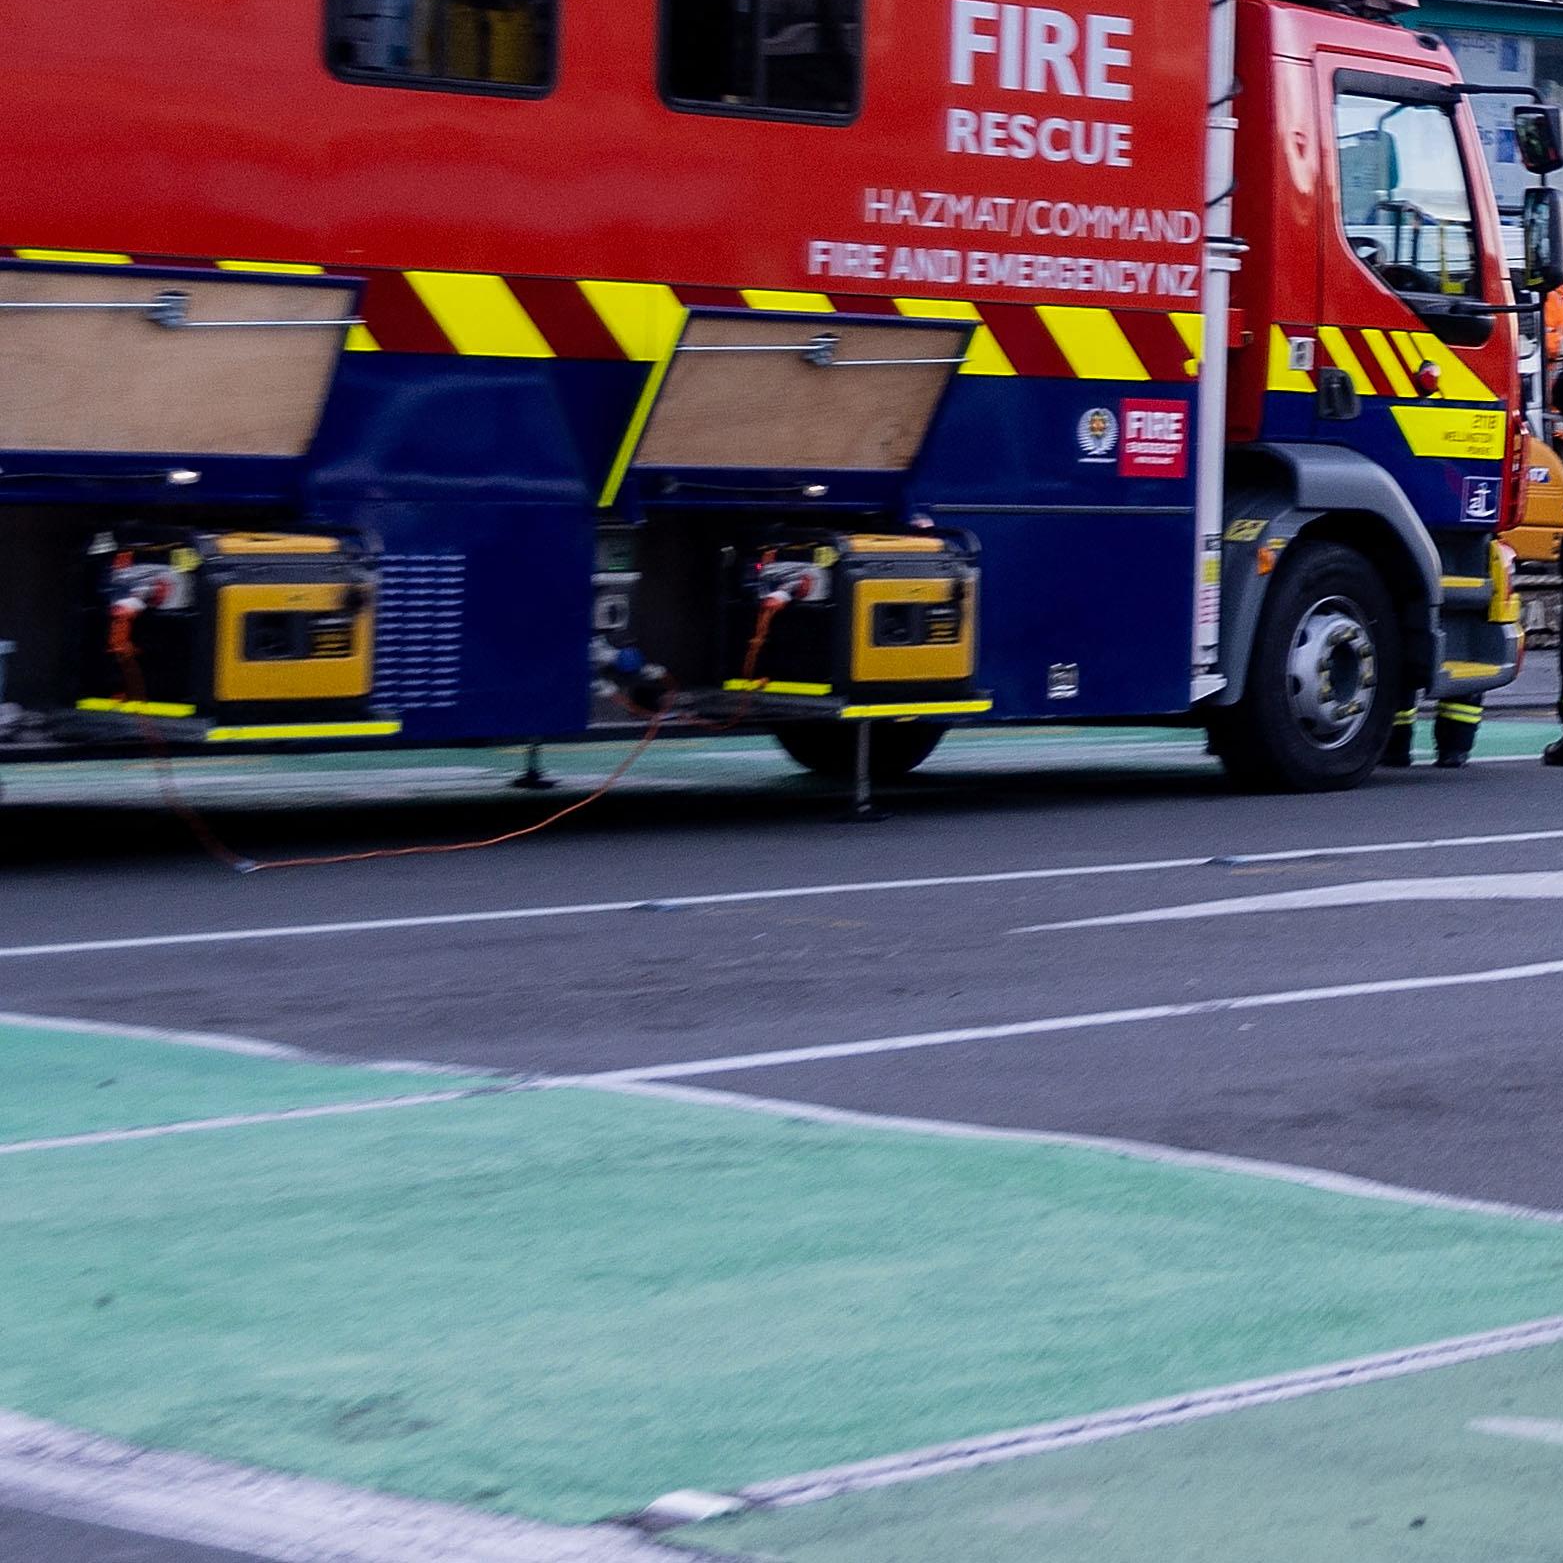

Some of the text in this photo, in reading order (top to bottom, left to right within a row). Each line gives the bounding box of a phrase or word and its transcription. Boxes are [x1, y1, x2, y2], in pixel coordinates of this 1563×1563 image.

[946, 107, 1134, 168] RESCUE
[863, 188, 1201, 245] HAZMAT/COMMAND
[807, 240, 1200, 297] FIRE AND EMERGENCY NZ
[1126, 410, 1185, 441] FIRE
